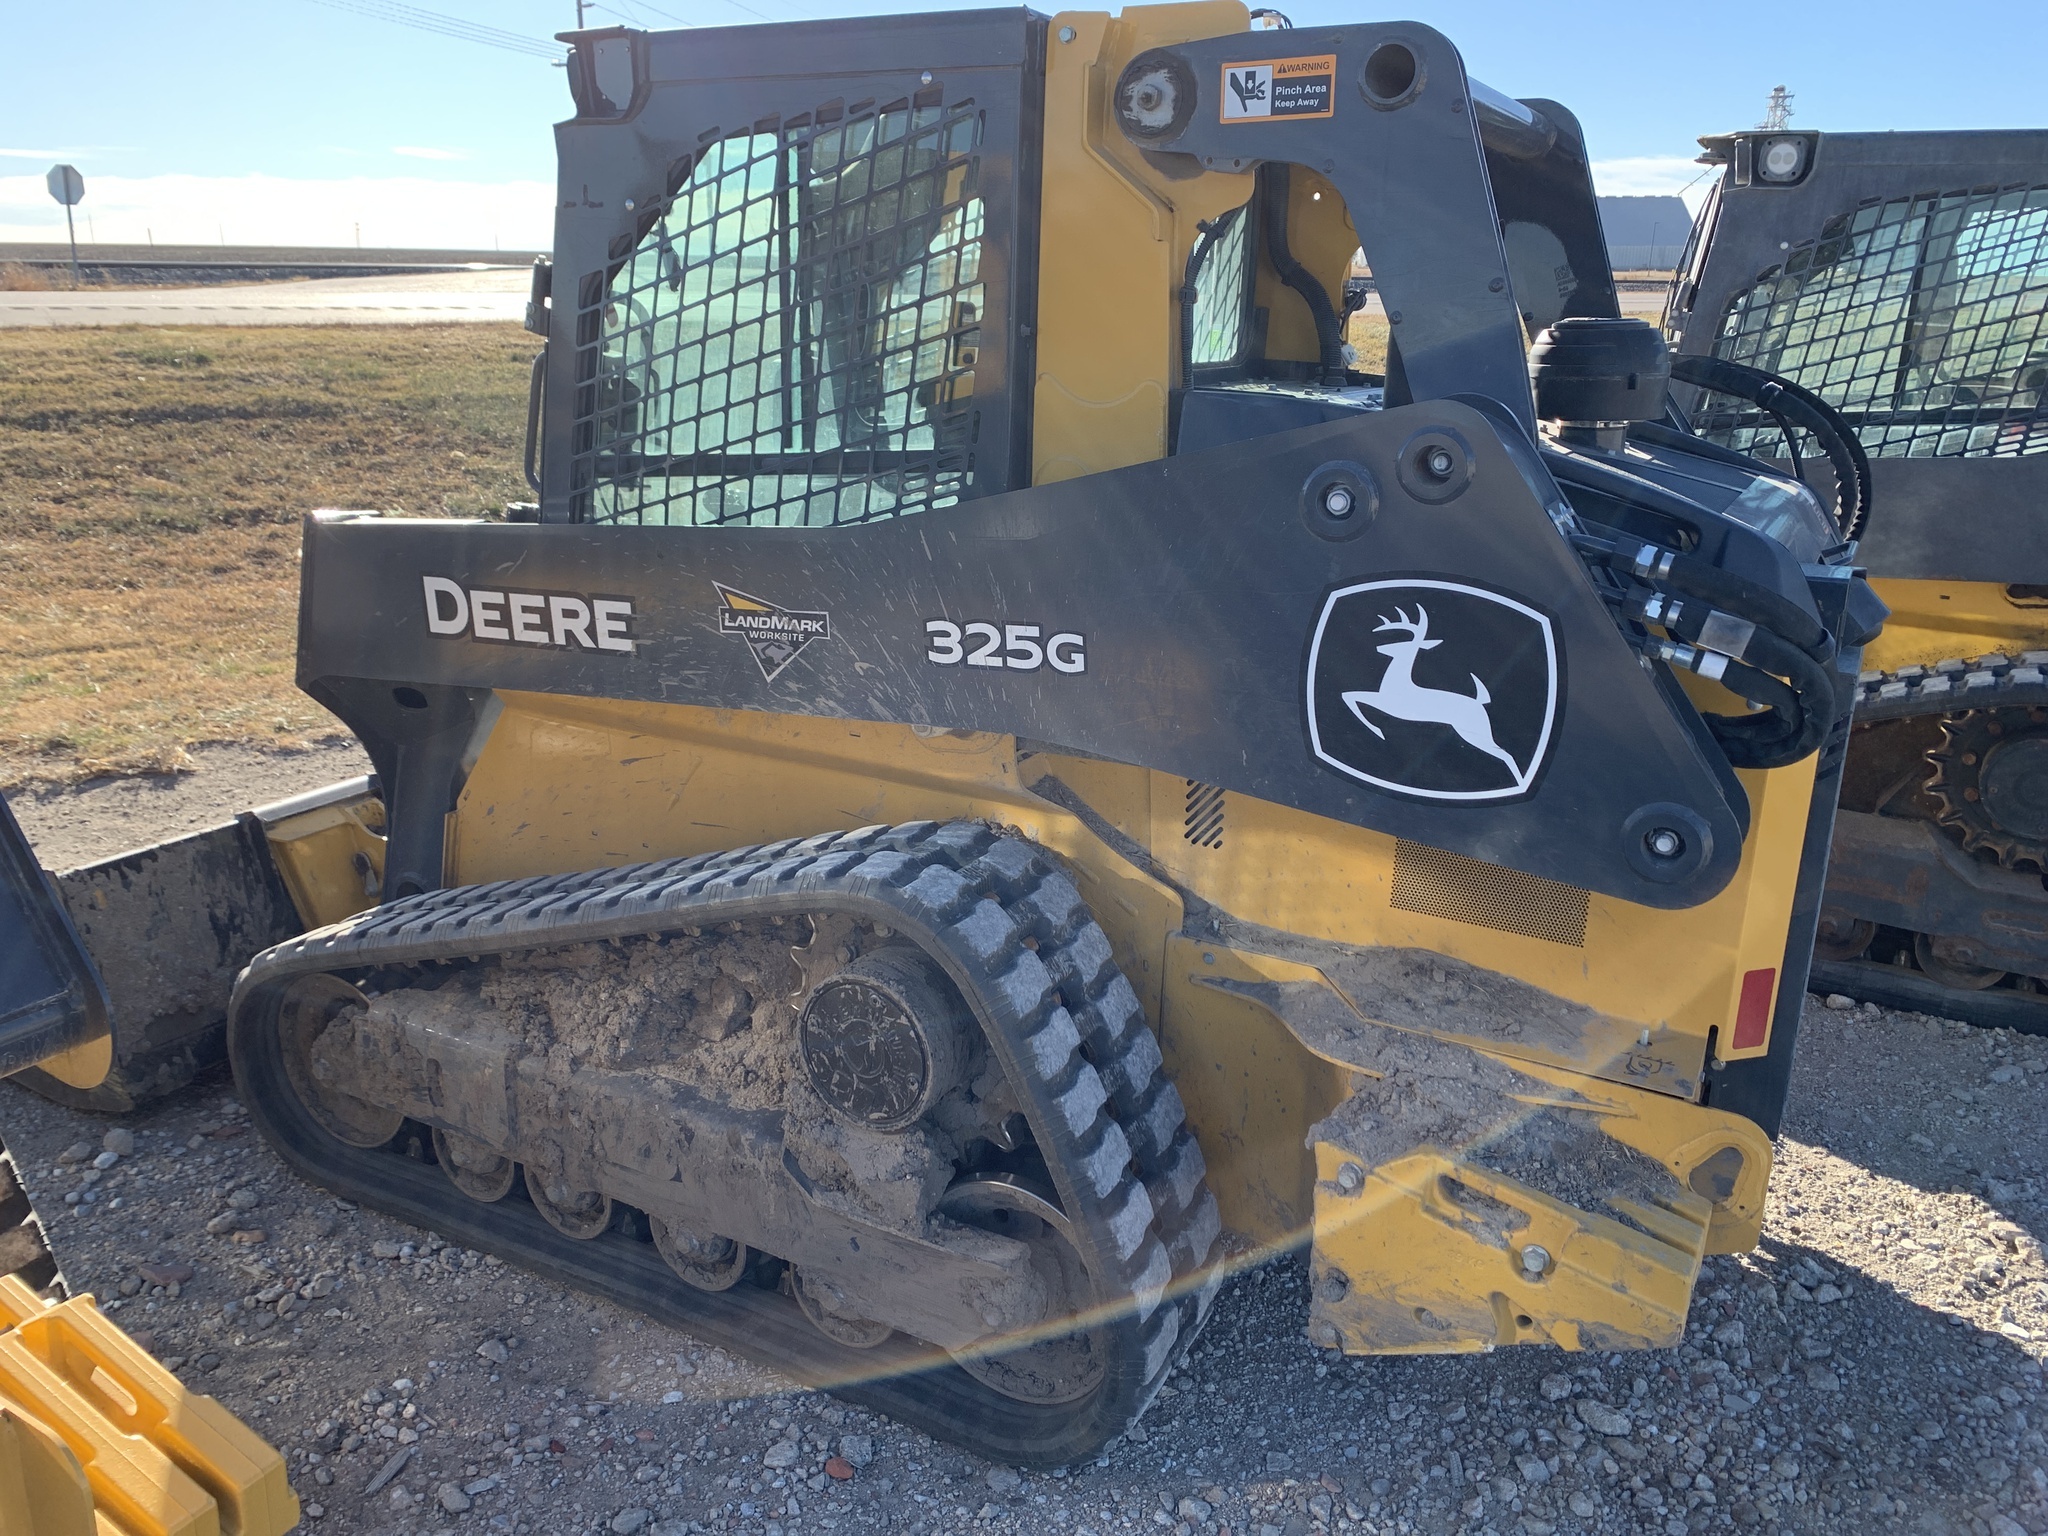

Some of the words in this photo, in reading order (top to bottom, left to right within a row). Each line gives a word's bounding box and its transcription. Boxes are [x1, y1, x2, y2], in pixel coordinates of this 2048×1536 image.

[1286, 62, 1330, 72] WARNING
[1275, 84, 1302, 96] Pinch
[1304, 84, 1327, 94] Area
[1275, 99, 1296, 109] Keep
[1297, 98, 1319, 107] Away
[422, 575, 636, 652] DEERE
[724, 612, 826, 634] LANDMARK
[749, 630, 805, 642] WORKSITE
[926, 620, 1085, 673] 325G
